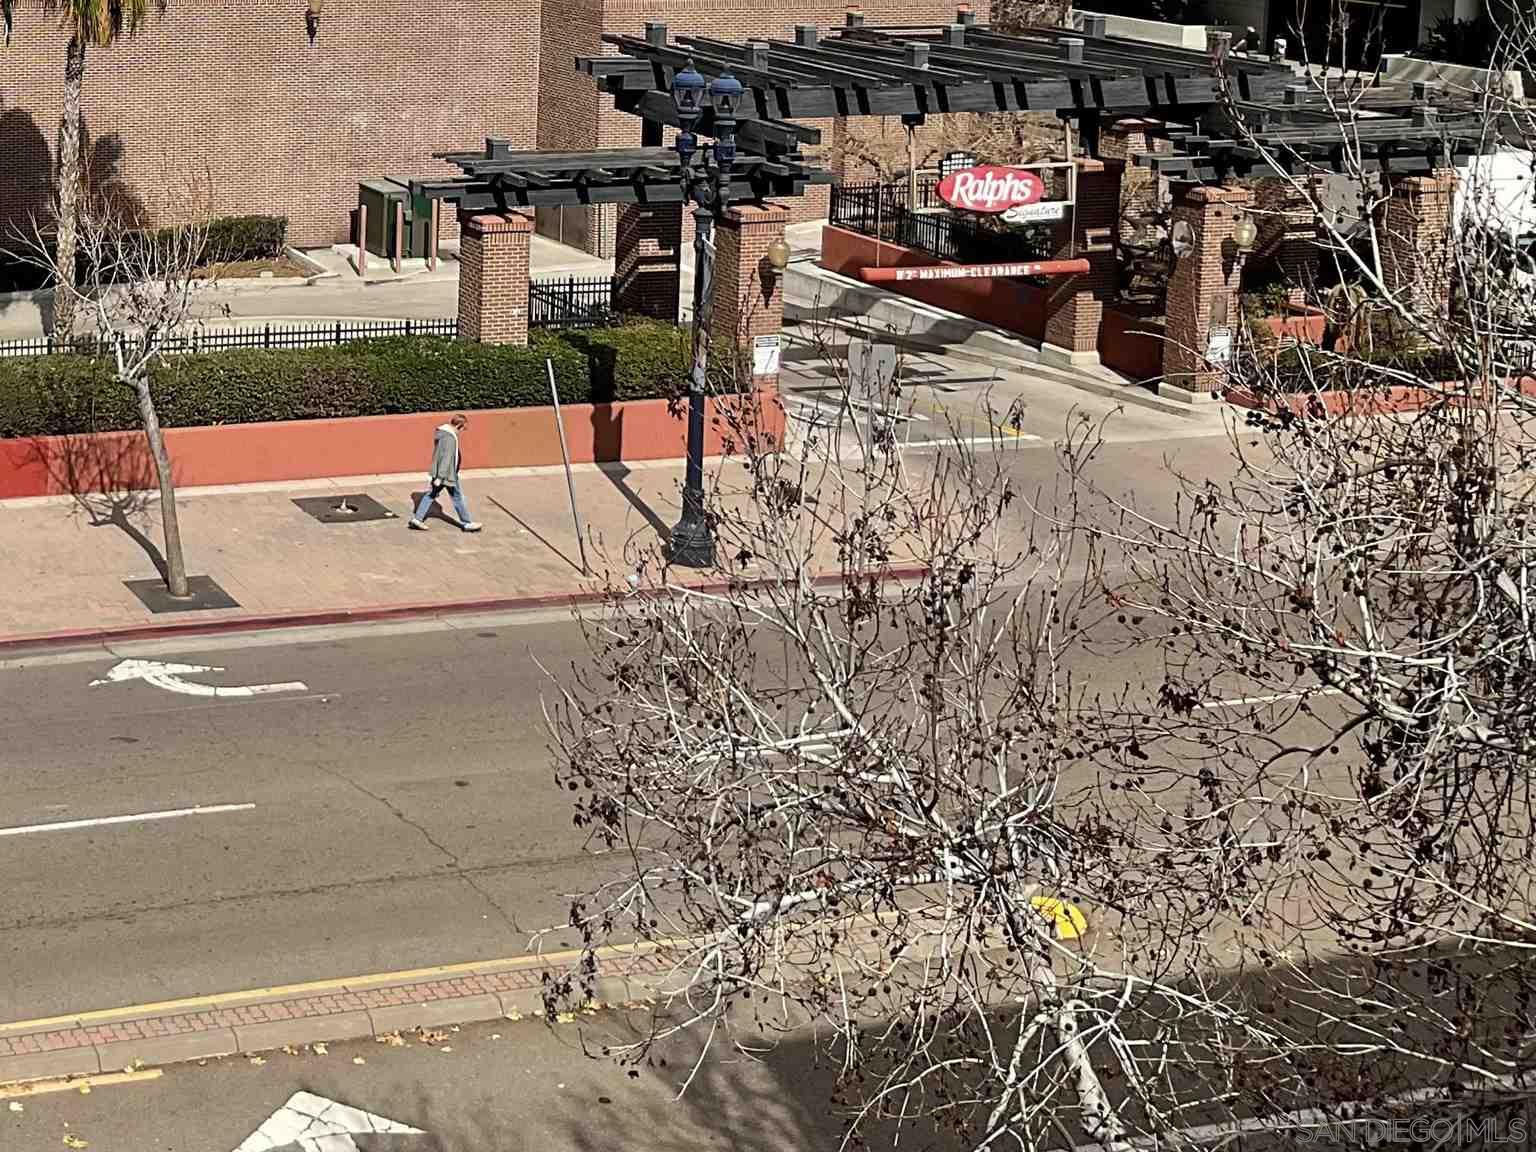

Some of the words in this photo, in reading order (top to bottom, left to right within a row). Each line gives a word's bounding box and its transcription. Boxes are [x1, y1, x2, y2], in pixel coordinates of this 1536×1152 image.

[952, 170, 1033, 207] Ralphs
[920, 266, 967, 280] MAXIMUM
[970, 264, 1030, 278] CLEARANCE
